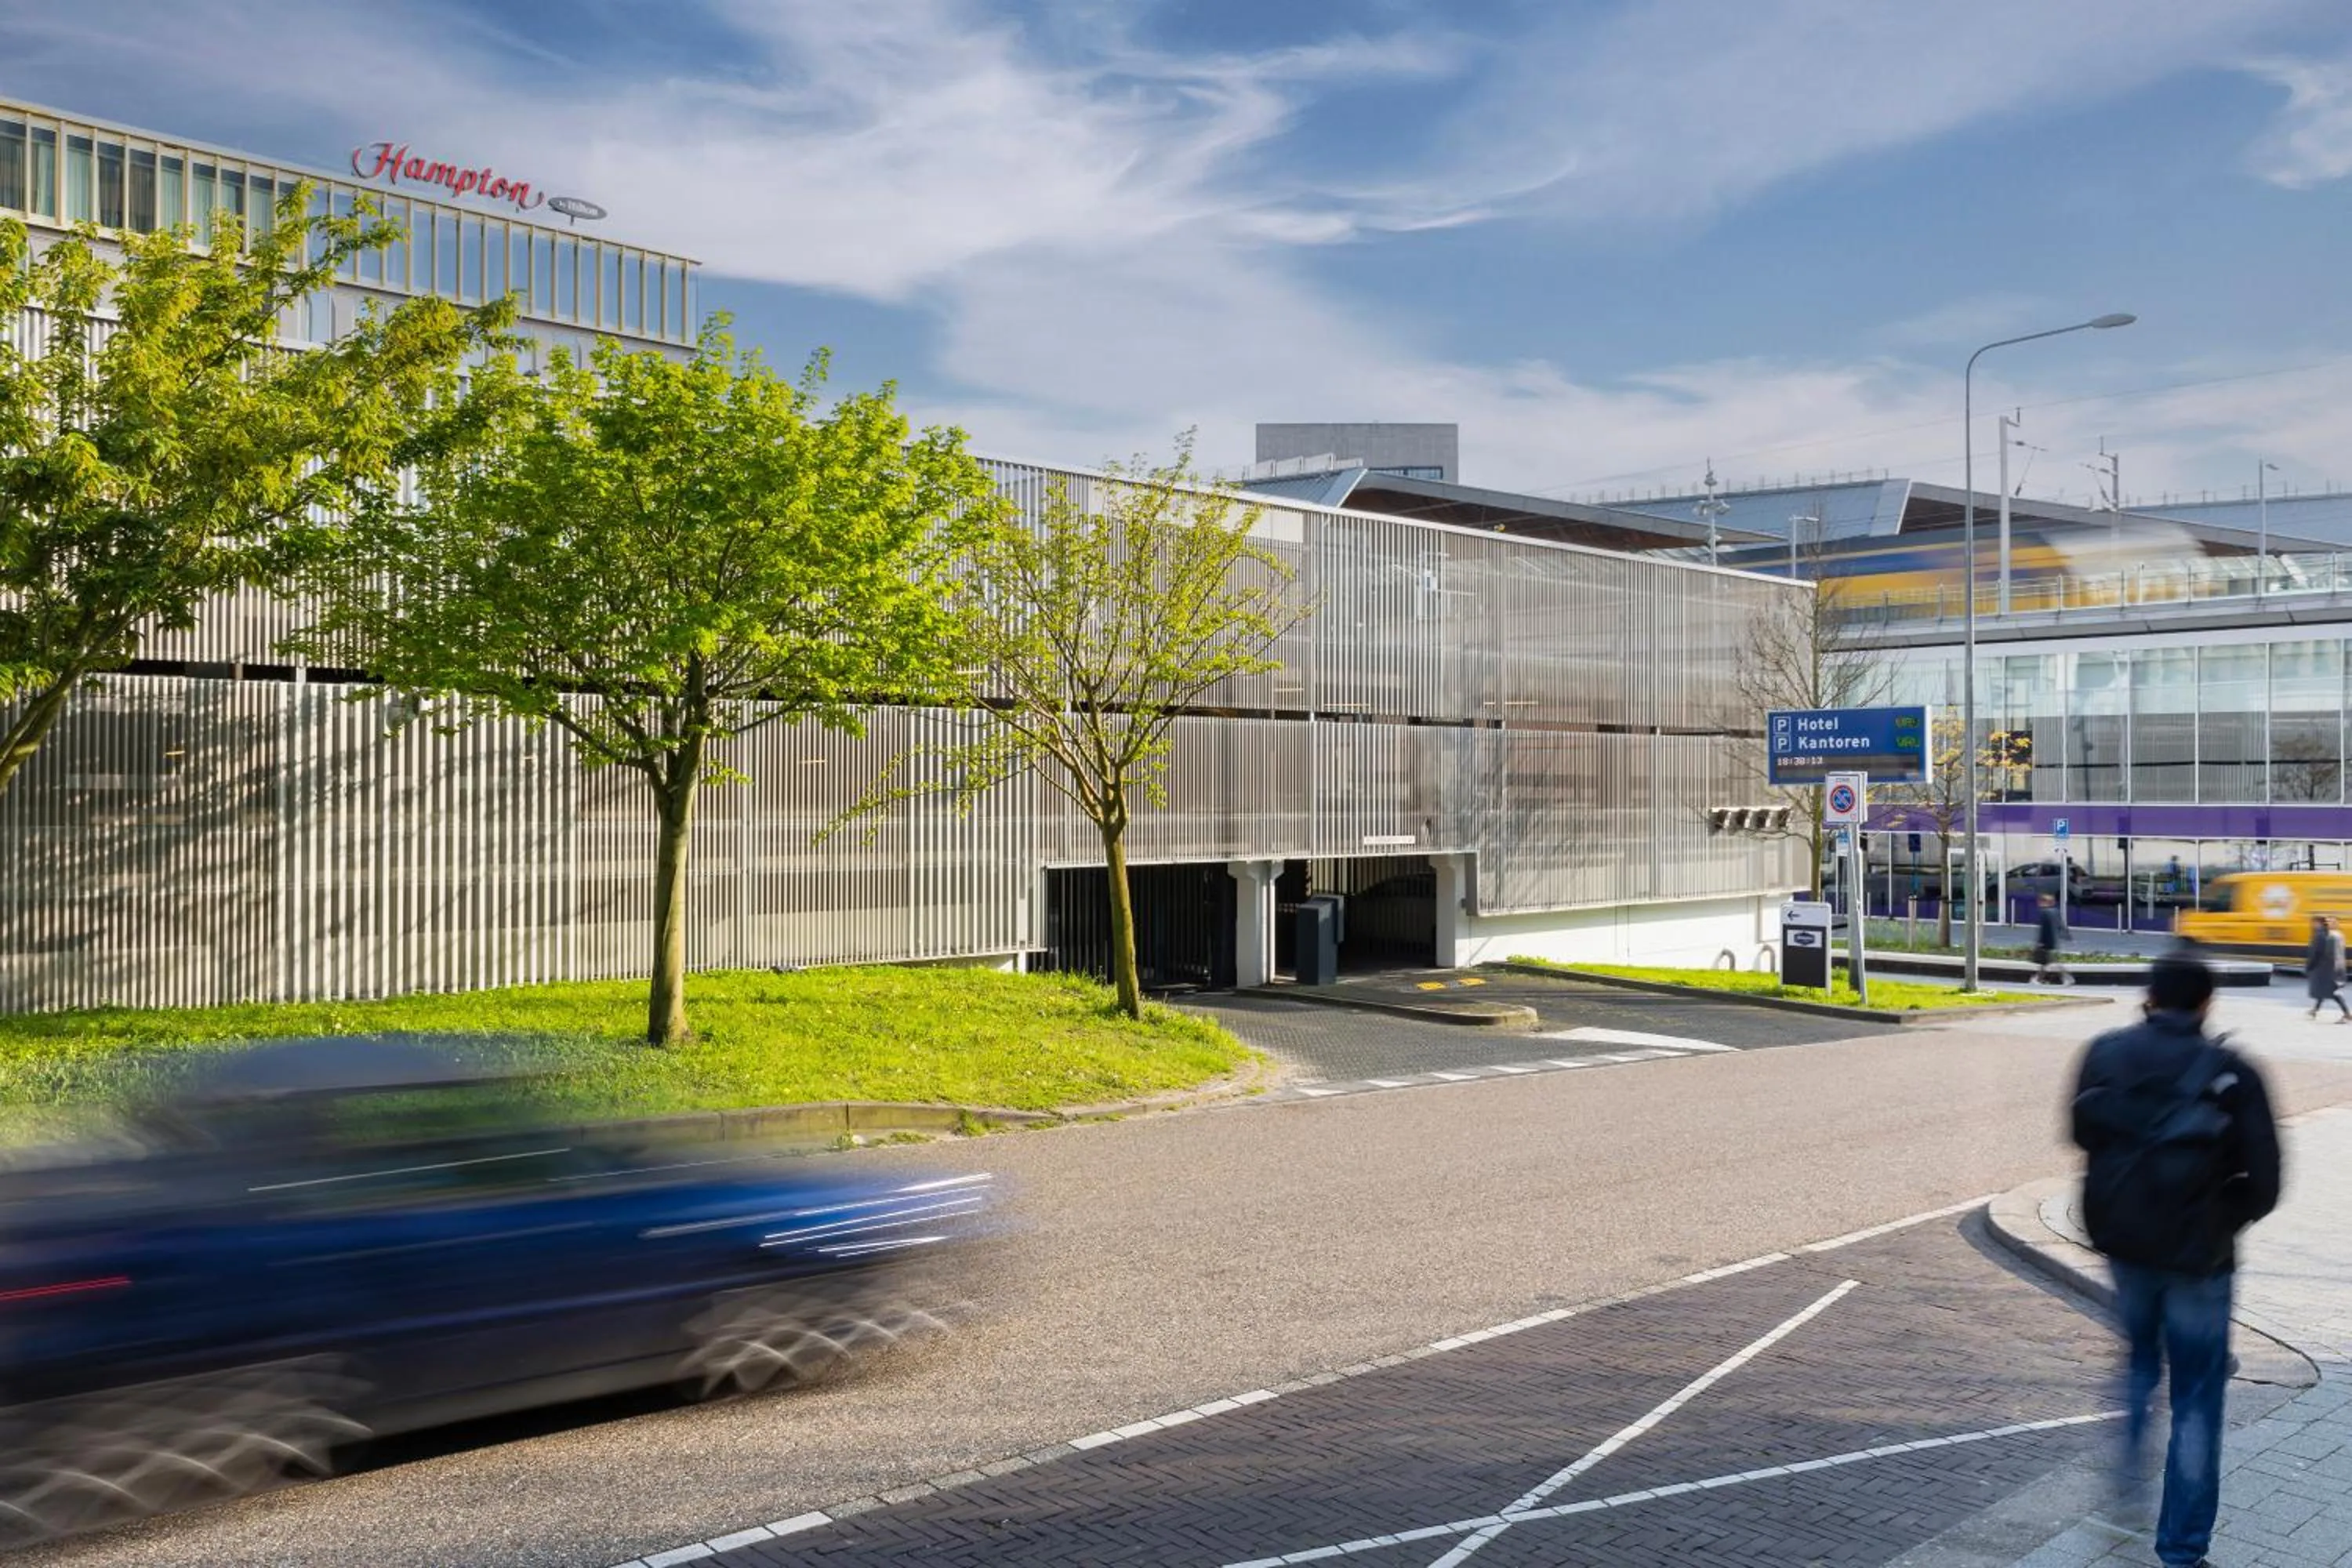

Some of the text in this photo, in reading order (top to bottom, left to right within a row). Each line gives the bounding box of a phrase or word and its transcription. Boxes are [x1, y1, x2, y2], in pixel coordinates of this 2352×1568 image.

[352, 142, 545, 210] Hampton
[1777, 717, 1838, 731] P Hotel
[1777, 736, 1870, 750] P Kantoren
